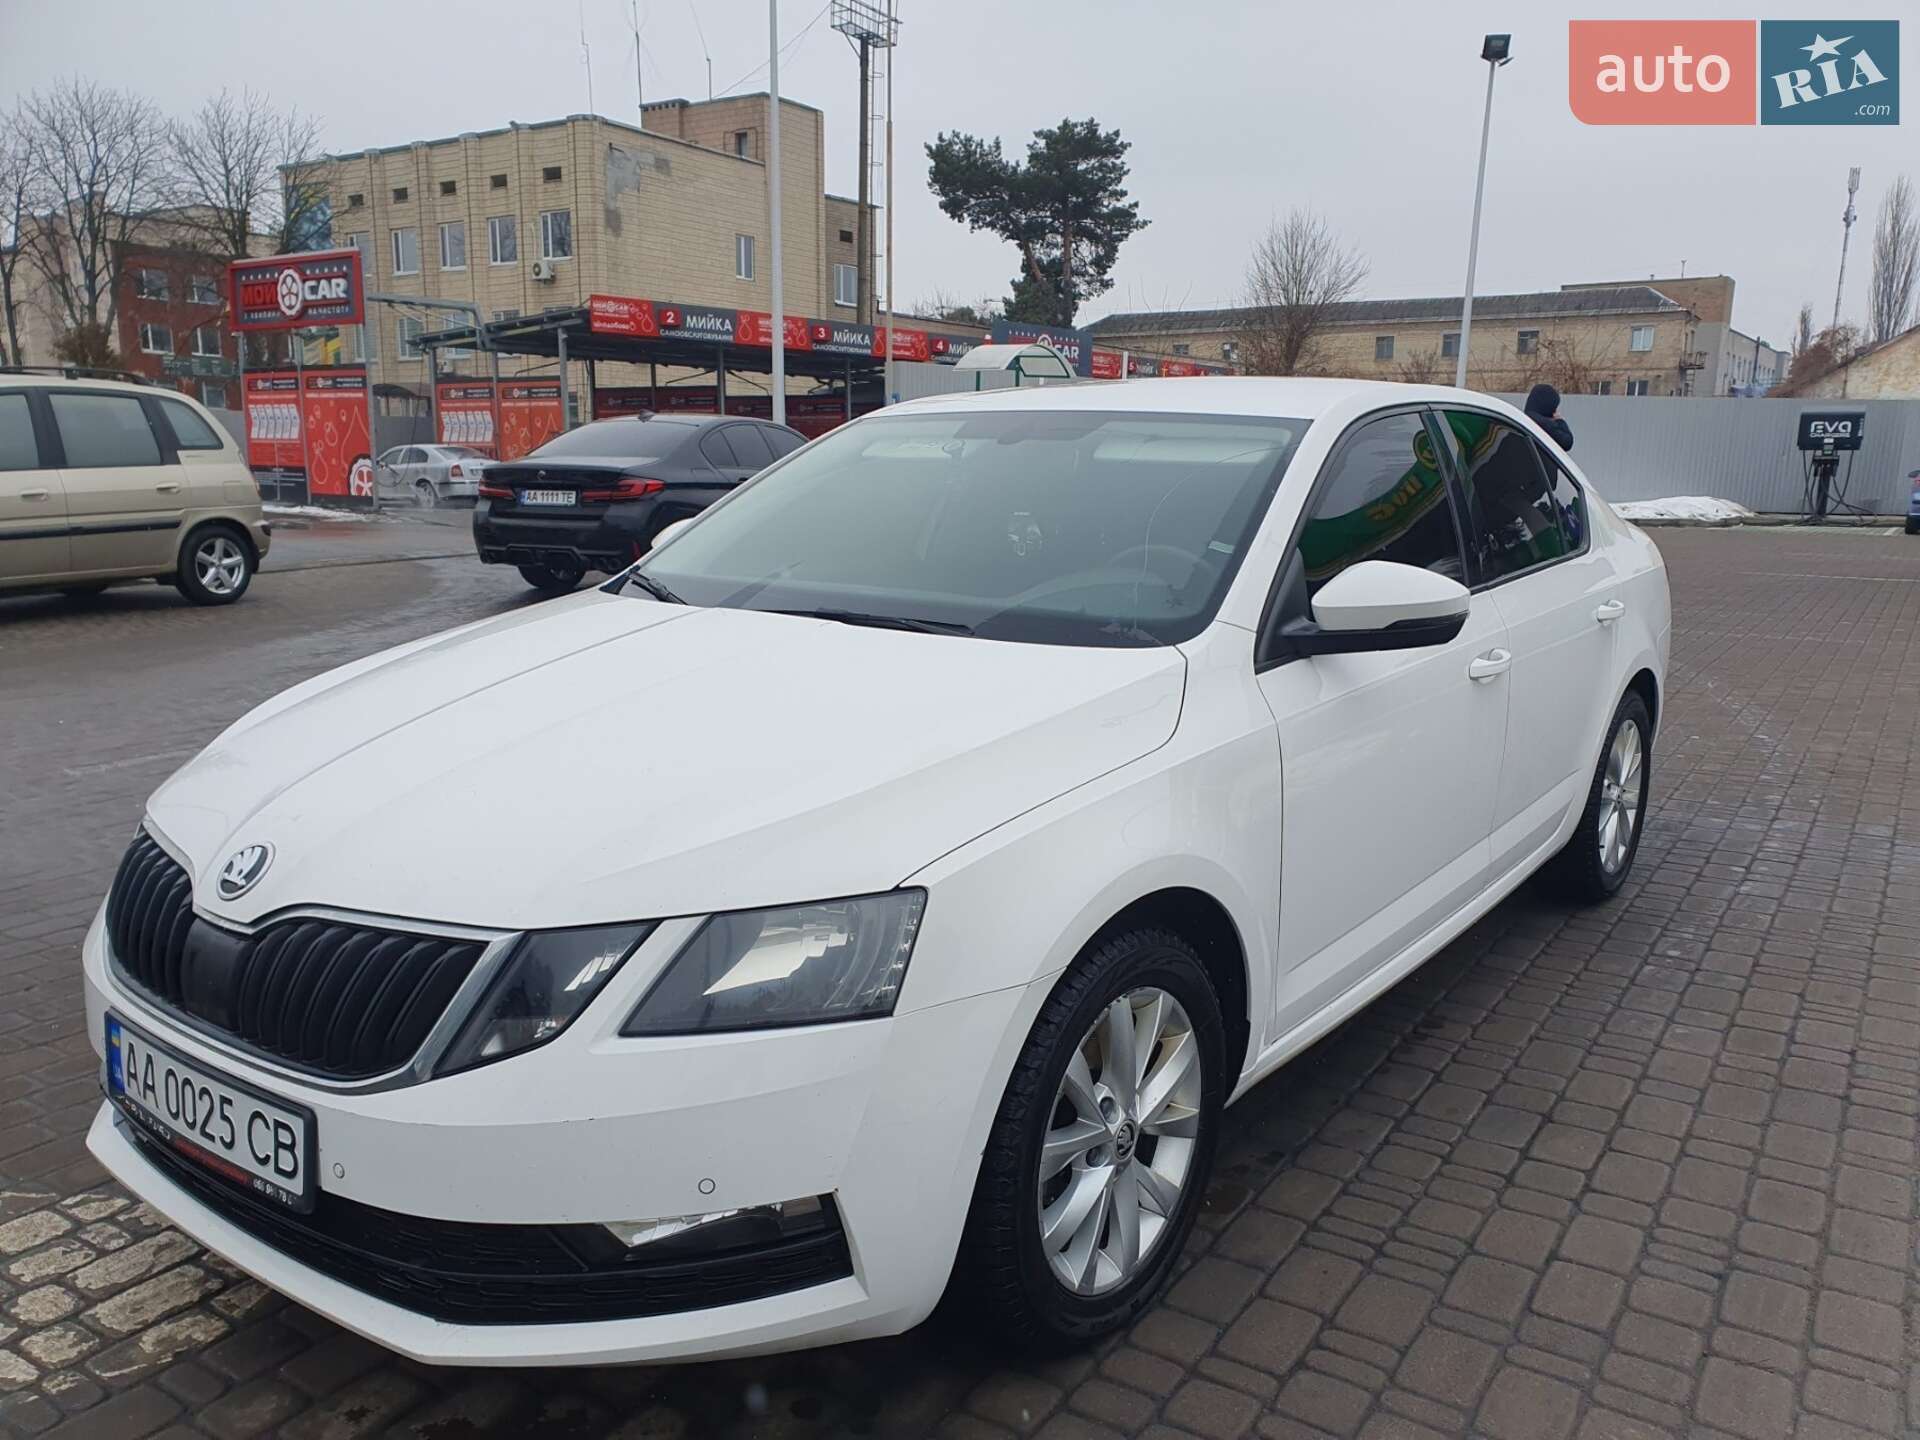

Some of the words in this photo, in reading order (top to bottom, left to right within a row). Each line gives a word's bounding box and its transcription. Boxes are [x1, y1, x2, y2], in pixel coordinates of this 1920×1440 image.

[304, 277, 348, 301] CAR
[666, 311, 675, 324] 2
[686, 314, 733, 332] МИЙКА
[818, 327, 827, 339] 3
[936, 341, 944, 351] 4
[948, 341, 974, 355] МИЙК
[540, 491, 559, 503] 1111
[560, 491, 574, 504] TE
[127, 1041, 160, 1109] AA
[164, 1067, 236, 1151] 0025
[247, 1110, 300, 1180] CB
